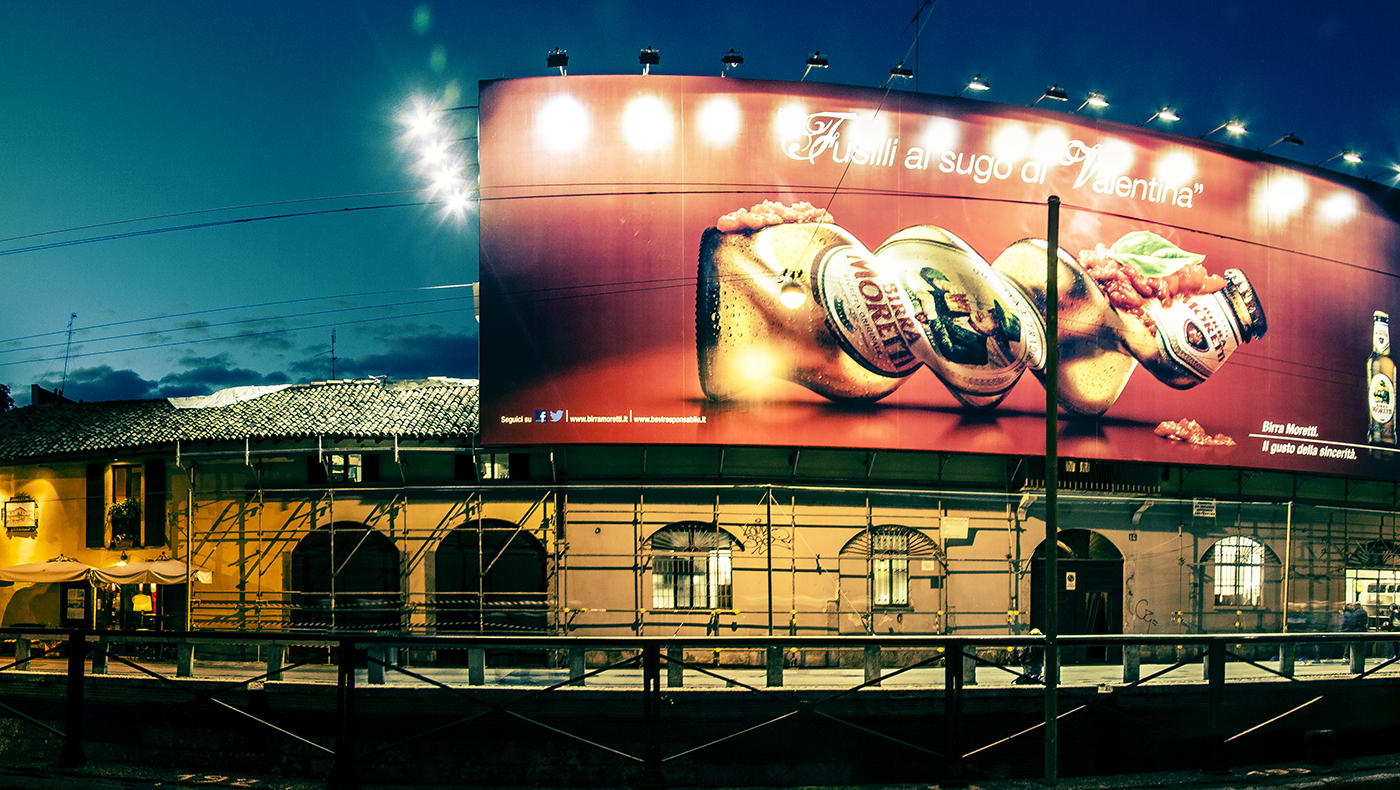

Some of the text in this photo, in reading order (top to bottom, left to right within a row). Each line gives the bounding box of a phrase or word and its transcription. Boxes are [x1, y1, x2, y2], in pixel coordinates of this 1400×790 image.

[904, 145, 931, 171] al
[938, 149, 1012, 184] sugo
[1020, 158, 1048, 185] di
[845, 253, 917, 370] MORETTI
[883, 282, 922, 347] BIRRA
[500, 415, 524, 425] Seguici
[569, 415, 629, 423] www.birramoretti.it
[633, 415, 707, 425] www.beviresponsabile.it
[1261, 420, 1319, 438] Birra Moretti.
[1261, 440, 1270, 452] Il
[1270, 442, 1296, 455] gusto
[1296, 443, 1319, 456] della
